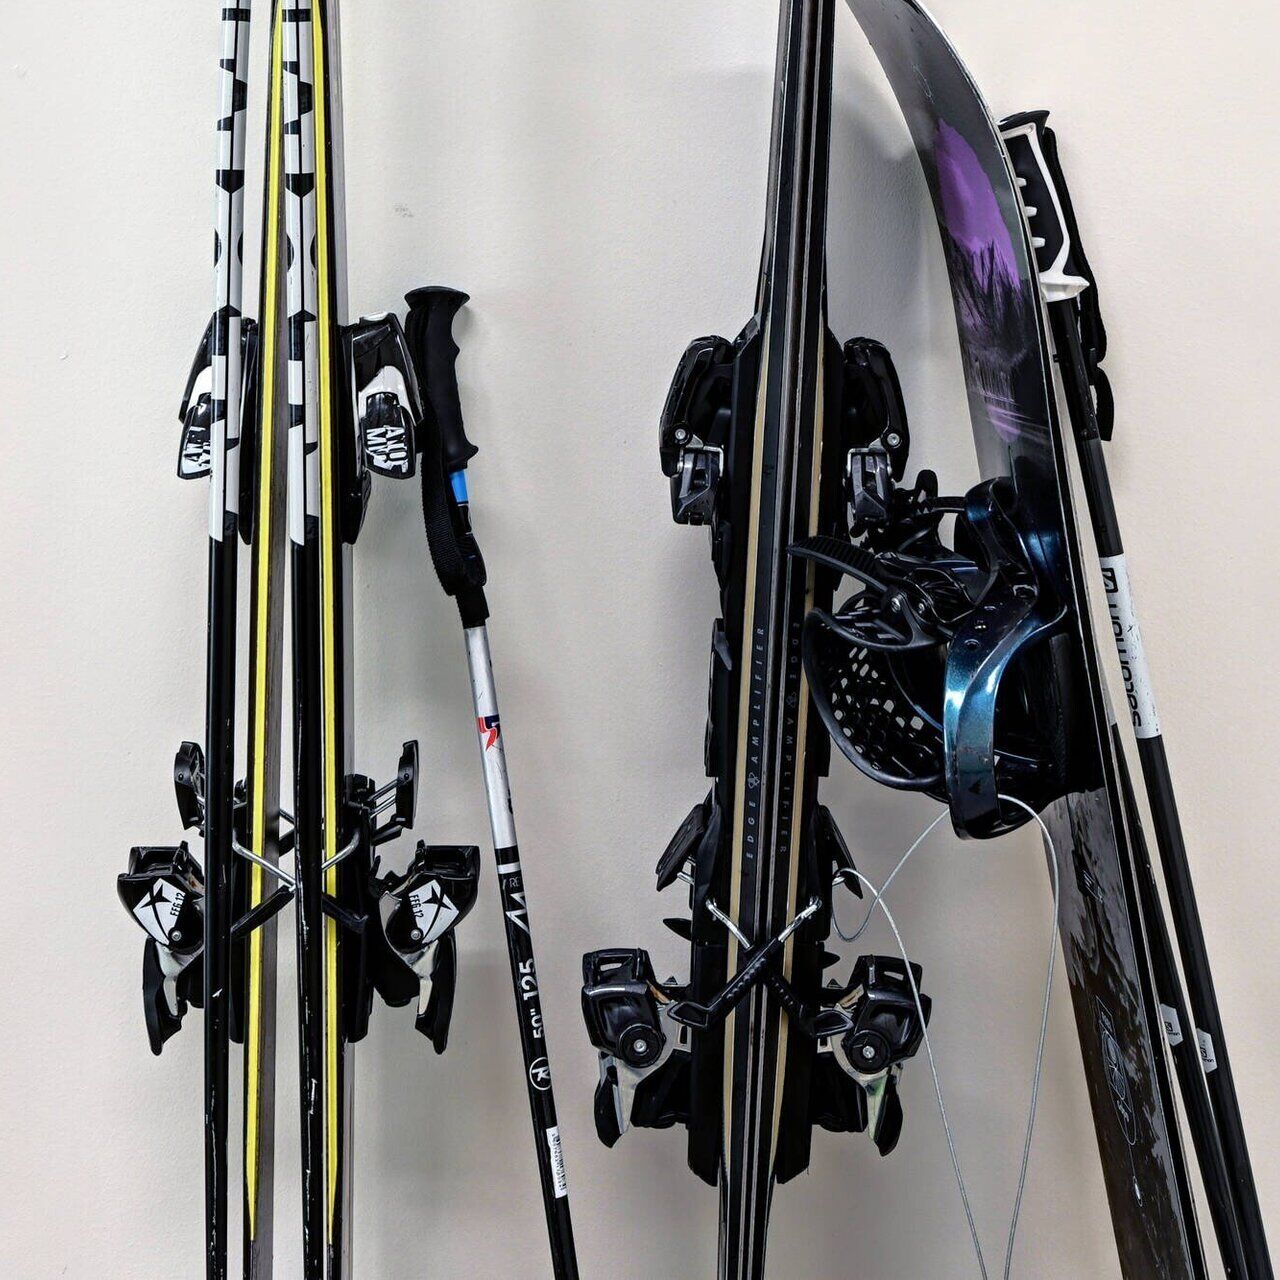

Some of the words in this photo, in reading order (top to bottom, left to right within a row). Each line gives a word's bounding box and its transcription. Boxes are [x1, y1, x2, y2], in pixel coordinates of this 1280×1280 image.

[751, 627, 765, 765] AMPLIFIER
[746, 800, 757, 860] EDGE
[518, 957, 538, 1001] 125
